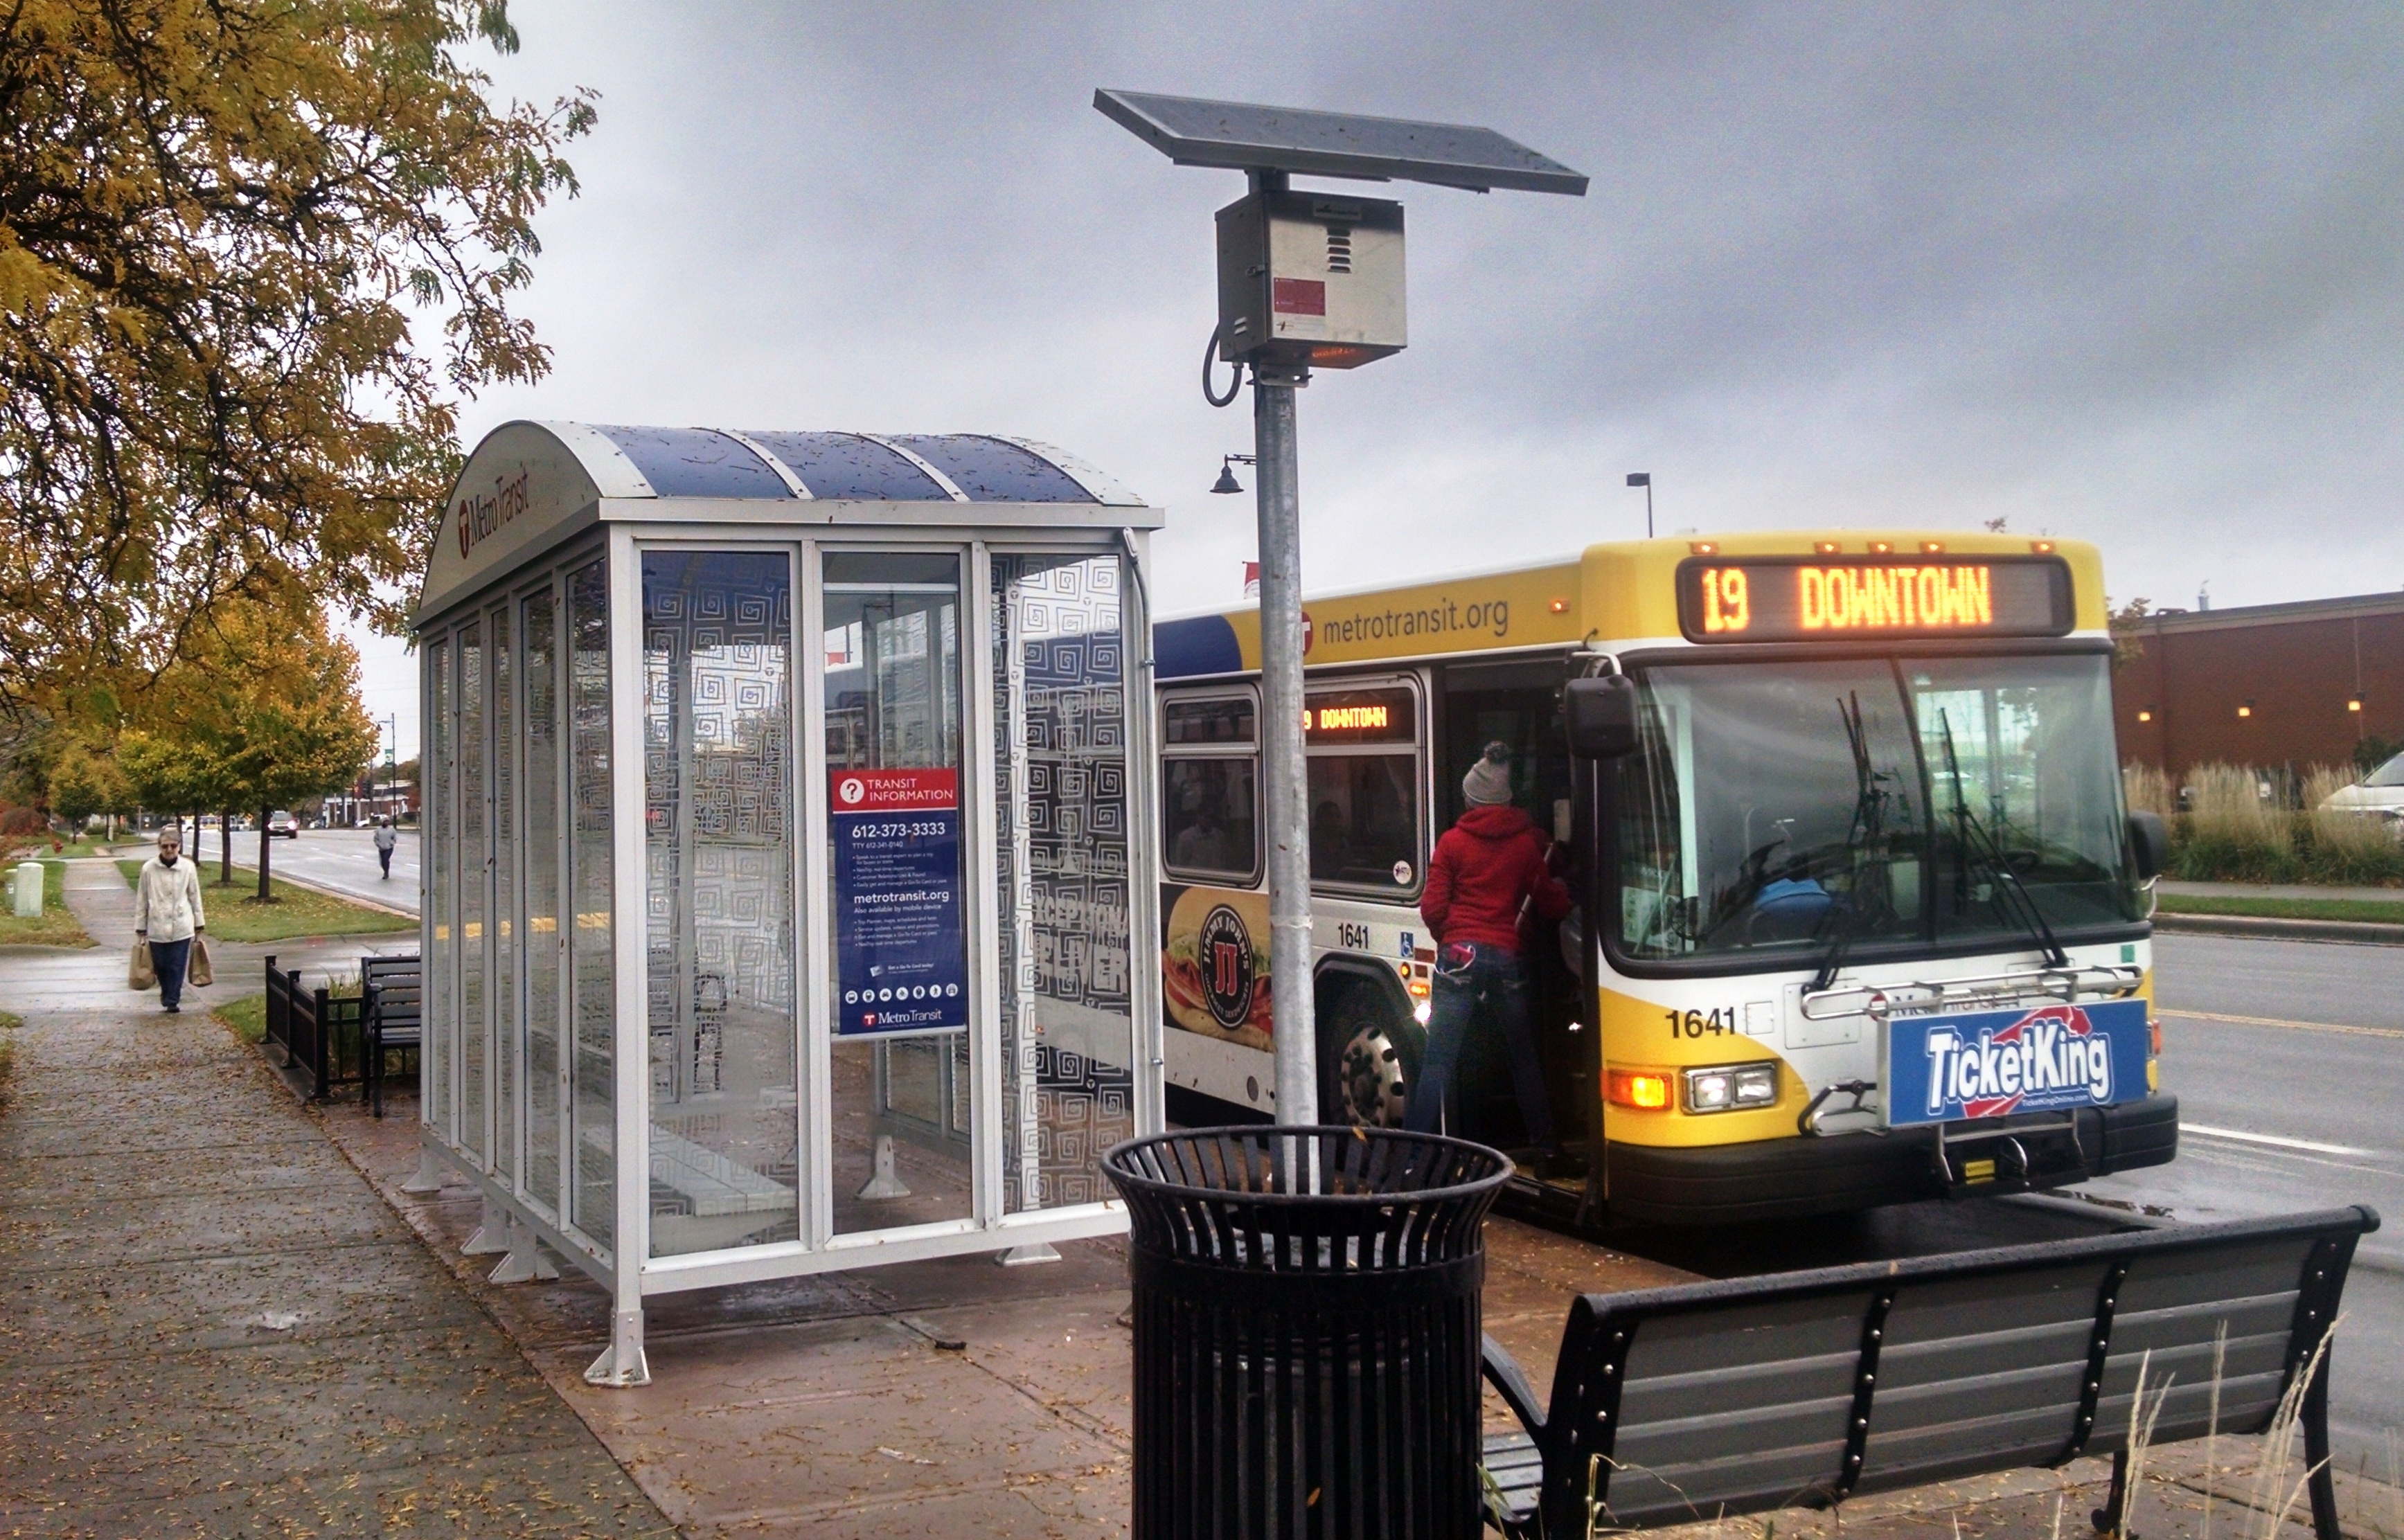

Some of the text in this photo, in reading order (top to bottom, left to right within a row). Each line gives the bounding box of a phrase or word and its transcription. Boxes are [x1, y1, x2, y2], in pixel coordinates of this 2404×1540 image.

[1702, 566, 1992, 633] 19 DOWNTOWN
[1324, 597, 1508, 645] metrotransit.org
[1321, 706, 1387, 729] DOWNTOWN
[867, 778, 917, 789] TRANSIT
[870, 789, 953, 801] INFORMATION
[852, 822, 945, 839] 612-373-3333
[854, 890, 950, 903] metrotransit.org
[1203, 915, 1223, 965] JIMMY
[1338, 922, 1369, 949] 1641
[1666, 1006, 1736, 1039] 1641
[1928, 1023, 2111, 1109] TicketKing
